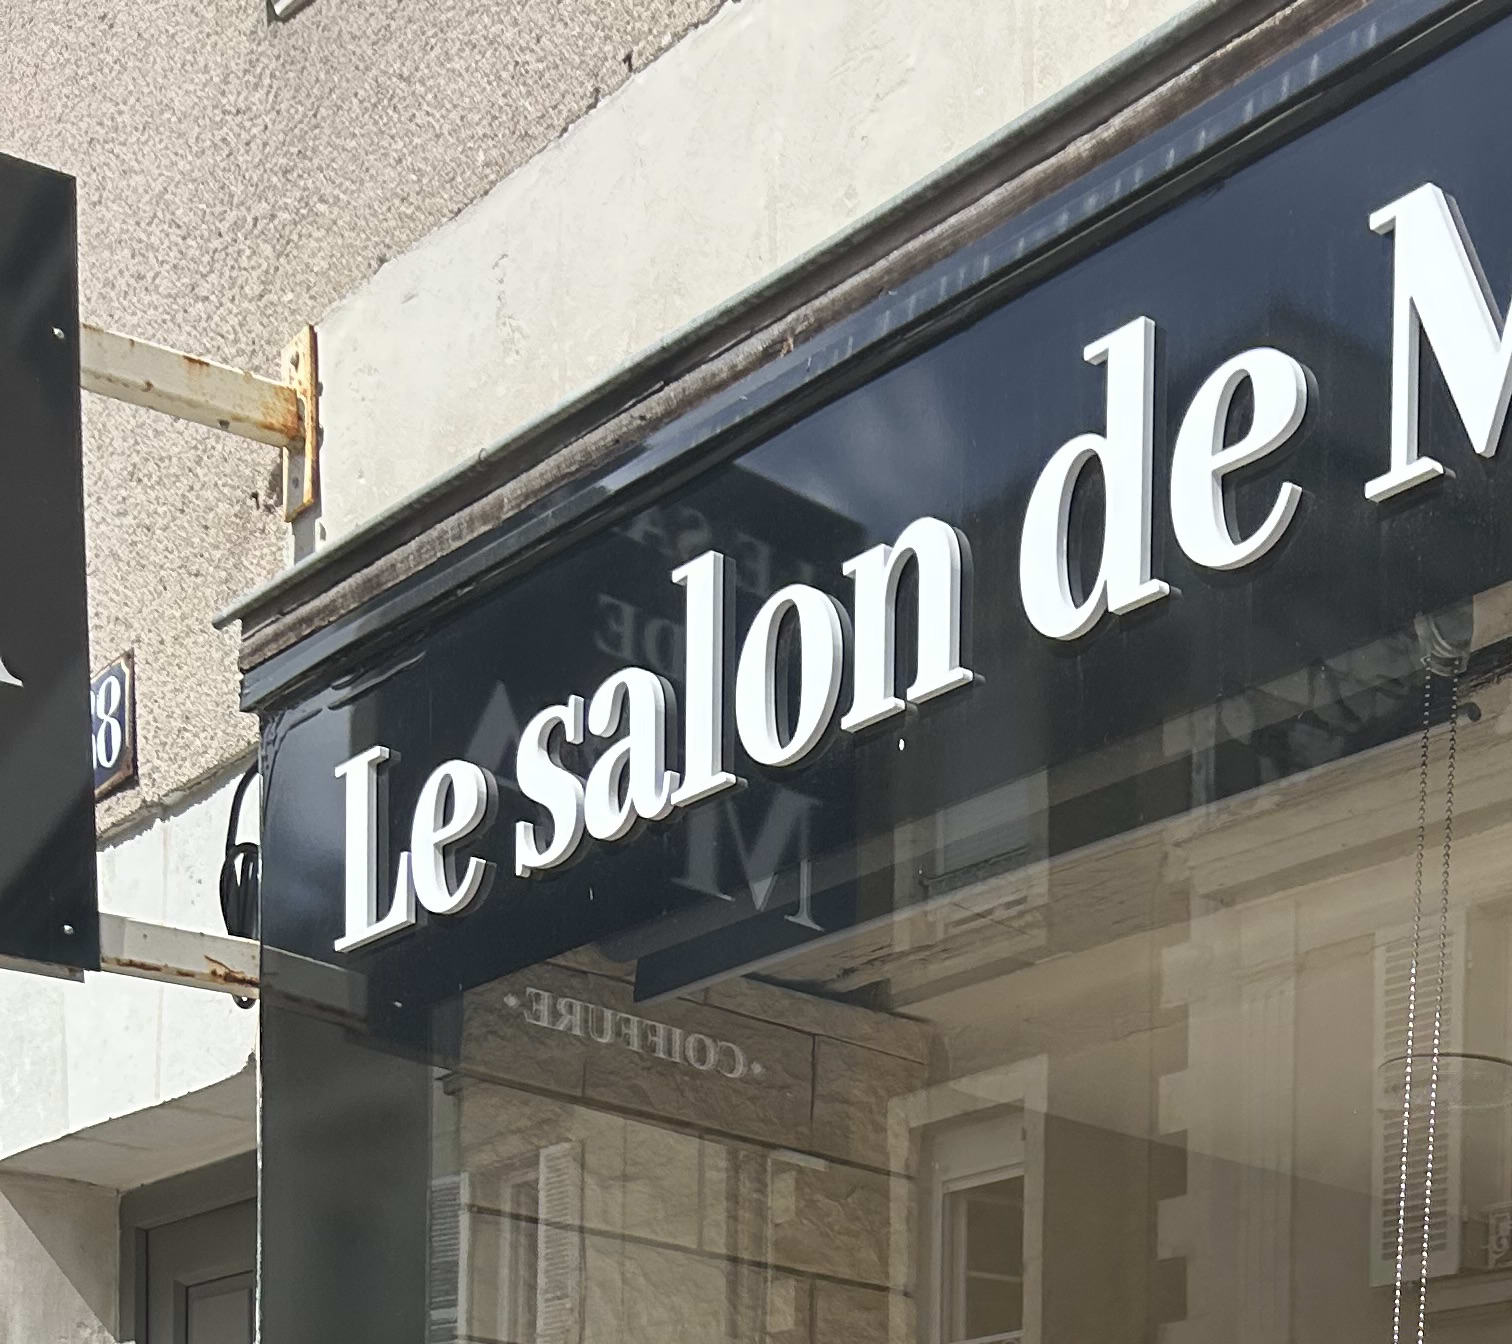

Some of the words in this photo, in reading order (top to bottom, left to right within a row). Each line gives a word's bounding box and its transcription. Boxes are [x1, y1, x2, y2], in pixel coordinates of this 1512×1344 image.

[334, 745, 494, 953] Le
[516, 516, 975, 876] salon
[1019, 315, 1308, 642] de
